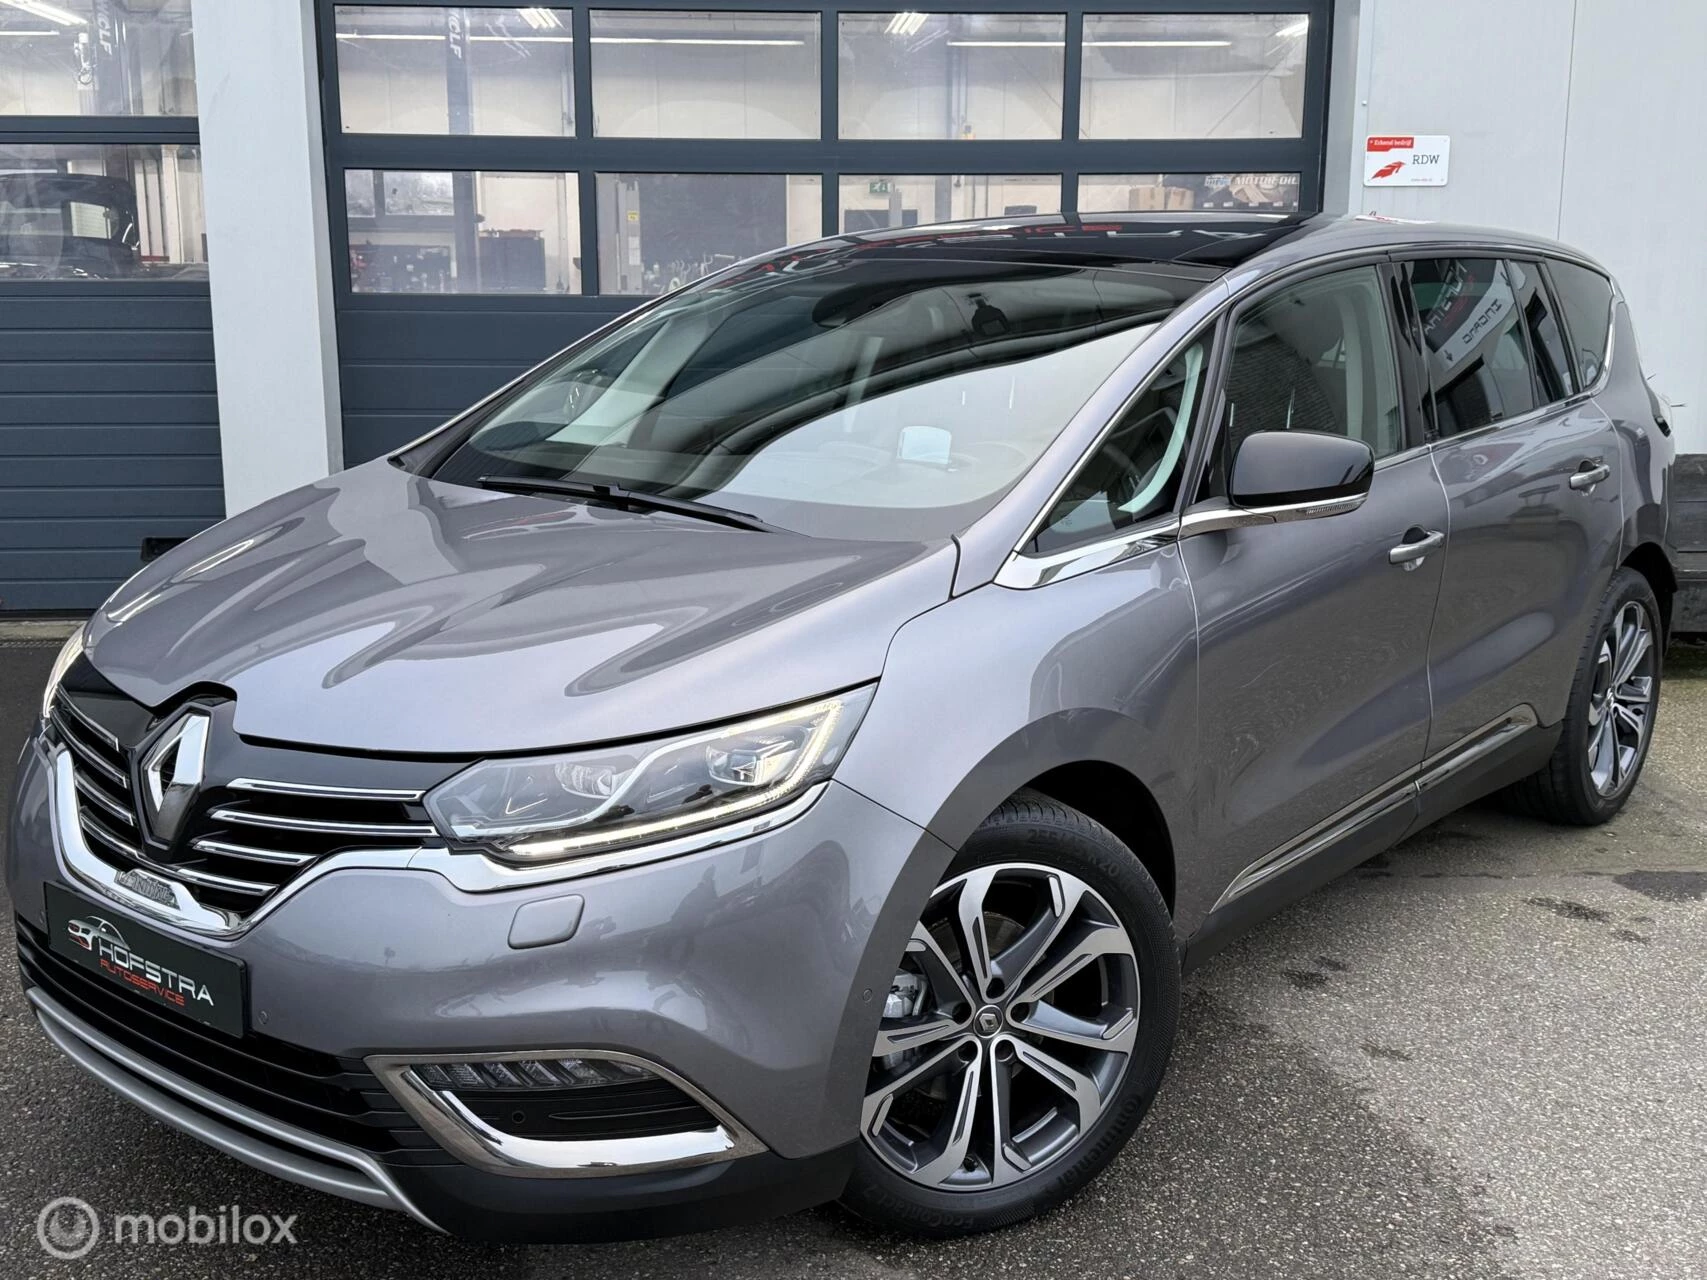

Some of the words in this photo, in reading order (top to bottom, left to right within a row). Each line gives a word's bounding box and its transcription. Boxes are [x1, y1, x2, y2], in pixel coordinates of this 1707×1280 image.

[1412, 154, 1440, 165] RDW
[99, 938, 215, 1007] HOFSTRA
[100, 958, 185, 1008] AUTOSERVICE
[1056, 1093, 1143, 1186] Continental
